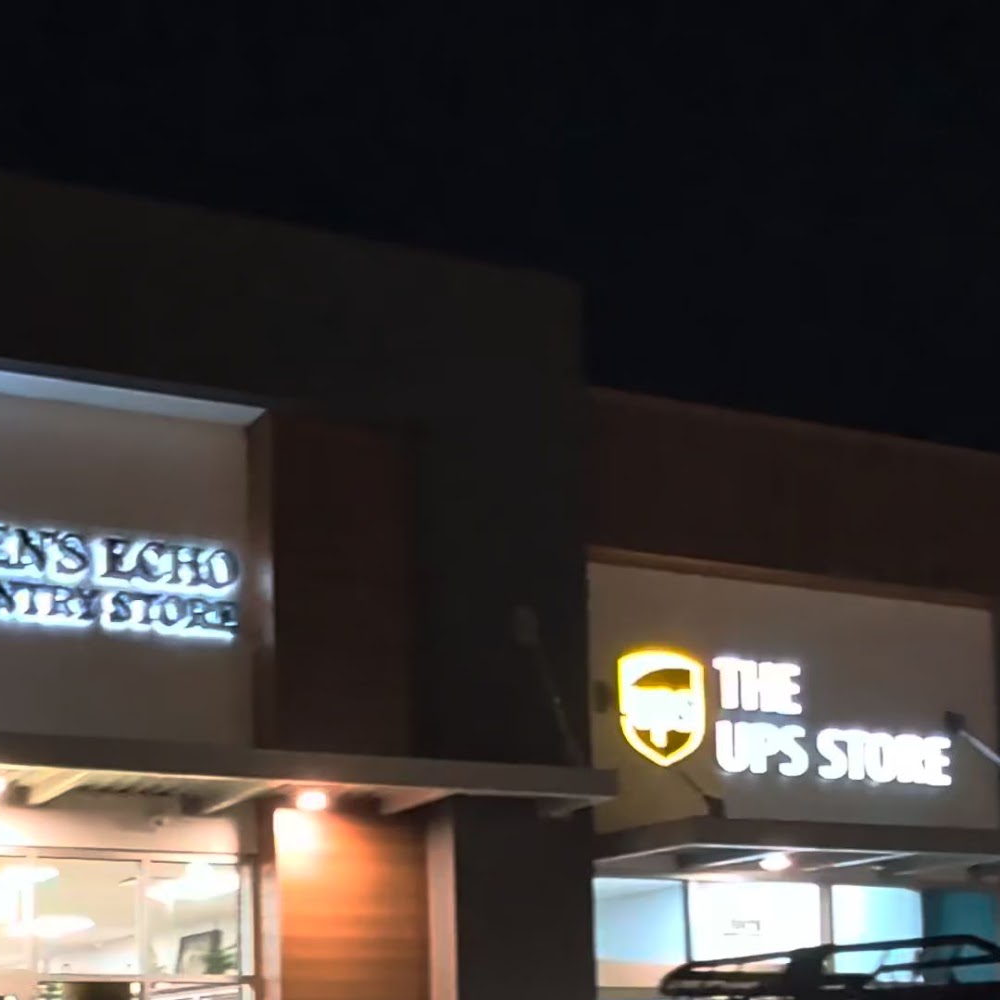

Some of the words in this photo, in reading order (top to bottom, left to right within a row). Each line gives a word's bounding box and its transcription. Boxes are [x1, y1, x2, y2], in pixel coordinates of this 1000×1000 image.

[98, 537, 240, 588] ECHO
[109, 590, 240, 631] STORE
[712, 656, 802, 715] THE
[715, 720, 809, 776] UPS
[816, 728, 952, 786] STORE
